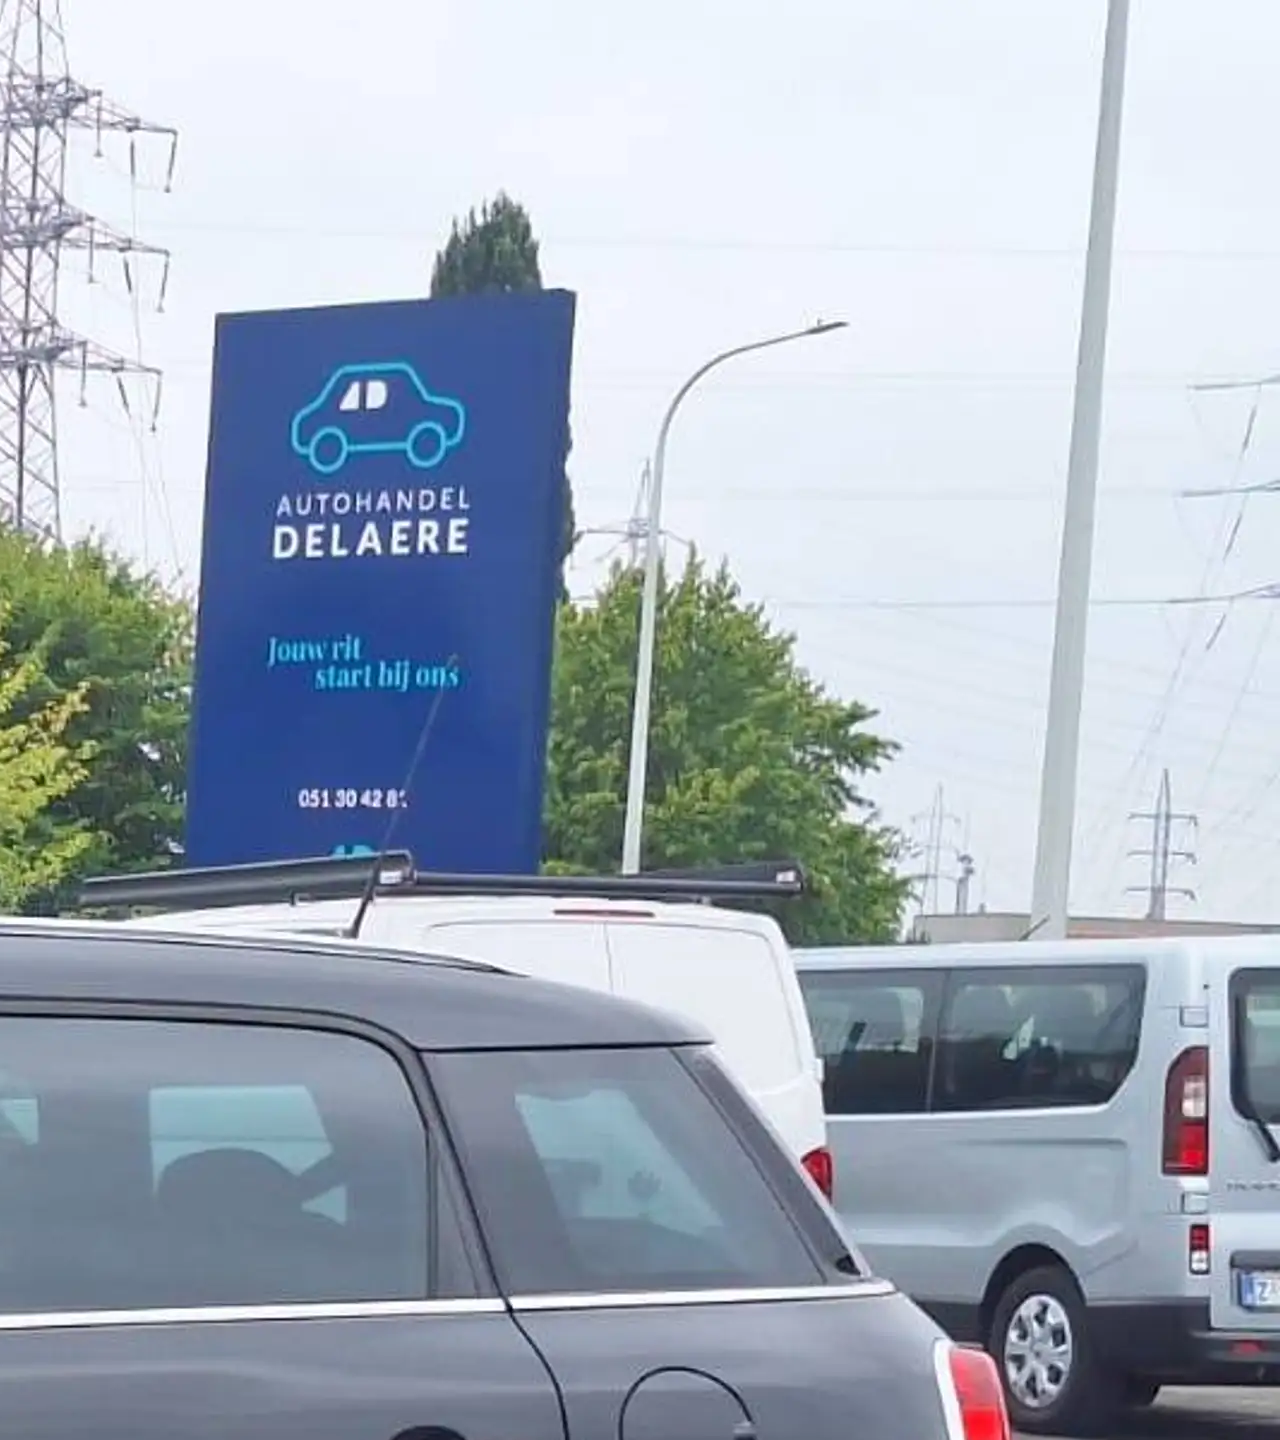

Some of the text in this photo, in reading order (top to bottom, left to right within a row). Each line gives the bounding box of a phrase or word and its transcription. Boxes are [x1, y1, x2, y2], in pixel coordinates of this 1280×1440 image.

[275, 485, 471, 518] AUTOHANDEL
[272, 517, 471, 560] DELAERE
[267, 633, 361, 668] Jouw rit
[314, 659, 460, 693] start bij ons
[297, 787, 330, 809] 051
[334, 787, 358, 809] 30
[360, 787, 383, 809] 42
